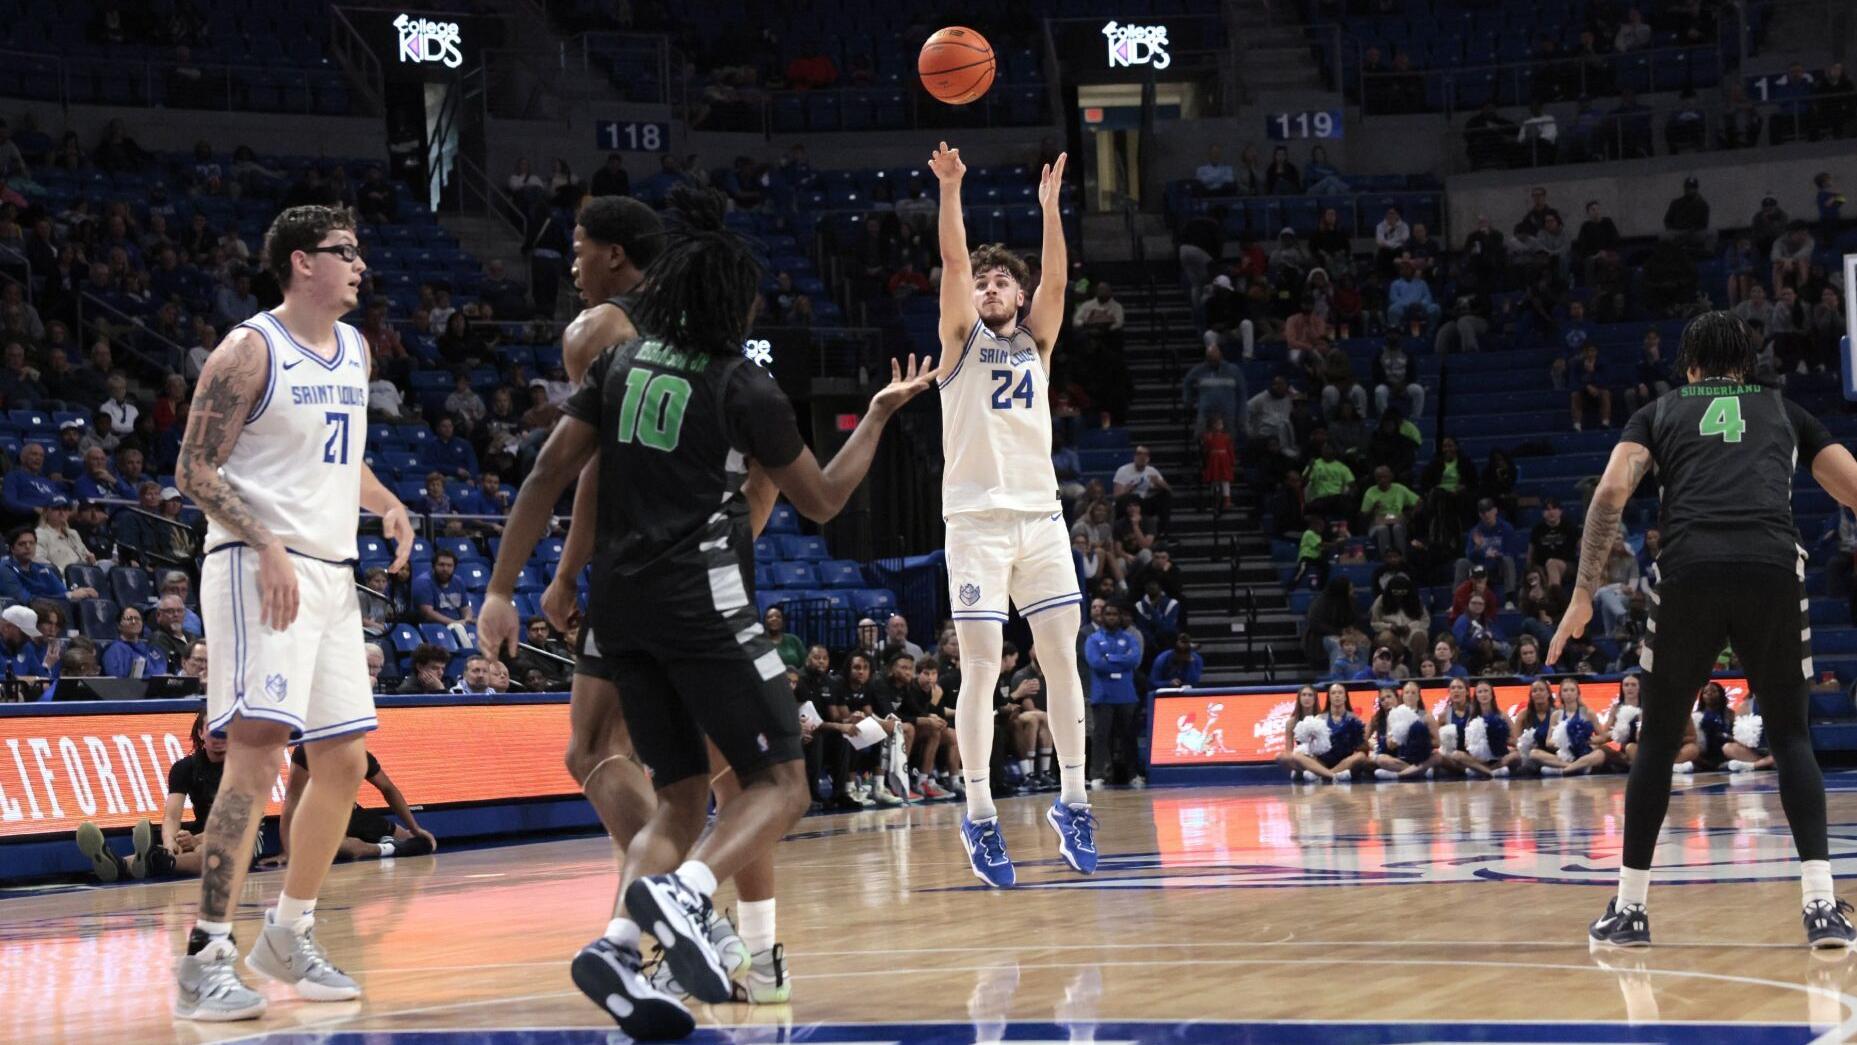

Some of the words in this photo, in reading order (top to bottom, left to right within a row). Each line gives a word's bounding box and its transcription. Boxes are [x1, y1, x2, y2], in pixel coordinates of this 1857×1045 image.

[399, 32, 462, 68] KIDS
[1108, 37, 1171, 69] KIDS
[606, 123, 661, 150] 118
[1276, 112, 1333, 139] 119
[979, 348, 1009, 364] SAIN
[291, 385, 334, 405] SAINT
[992, 369, 1034, 409] 24
[1681, 384, 1761, 397] SUNDERLAND
[618, 367, 692, 452] 10
[1699, 396, 1746, 442] 4
[323, 412, 349, 465] 21
